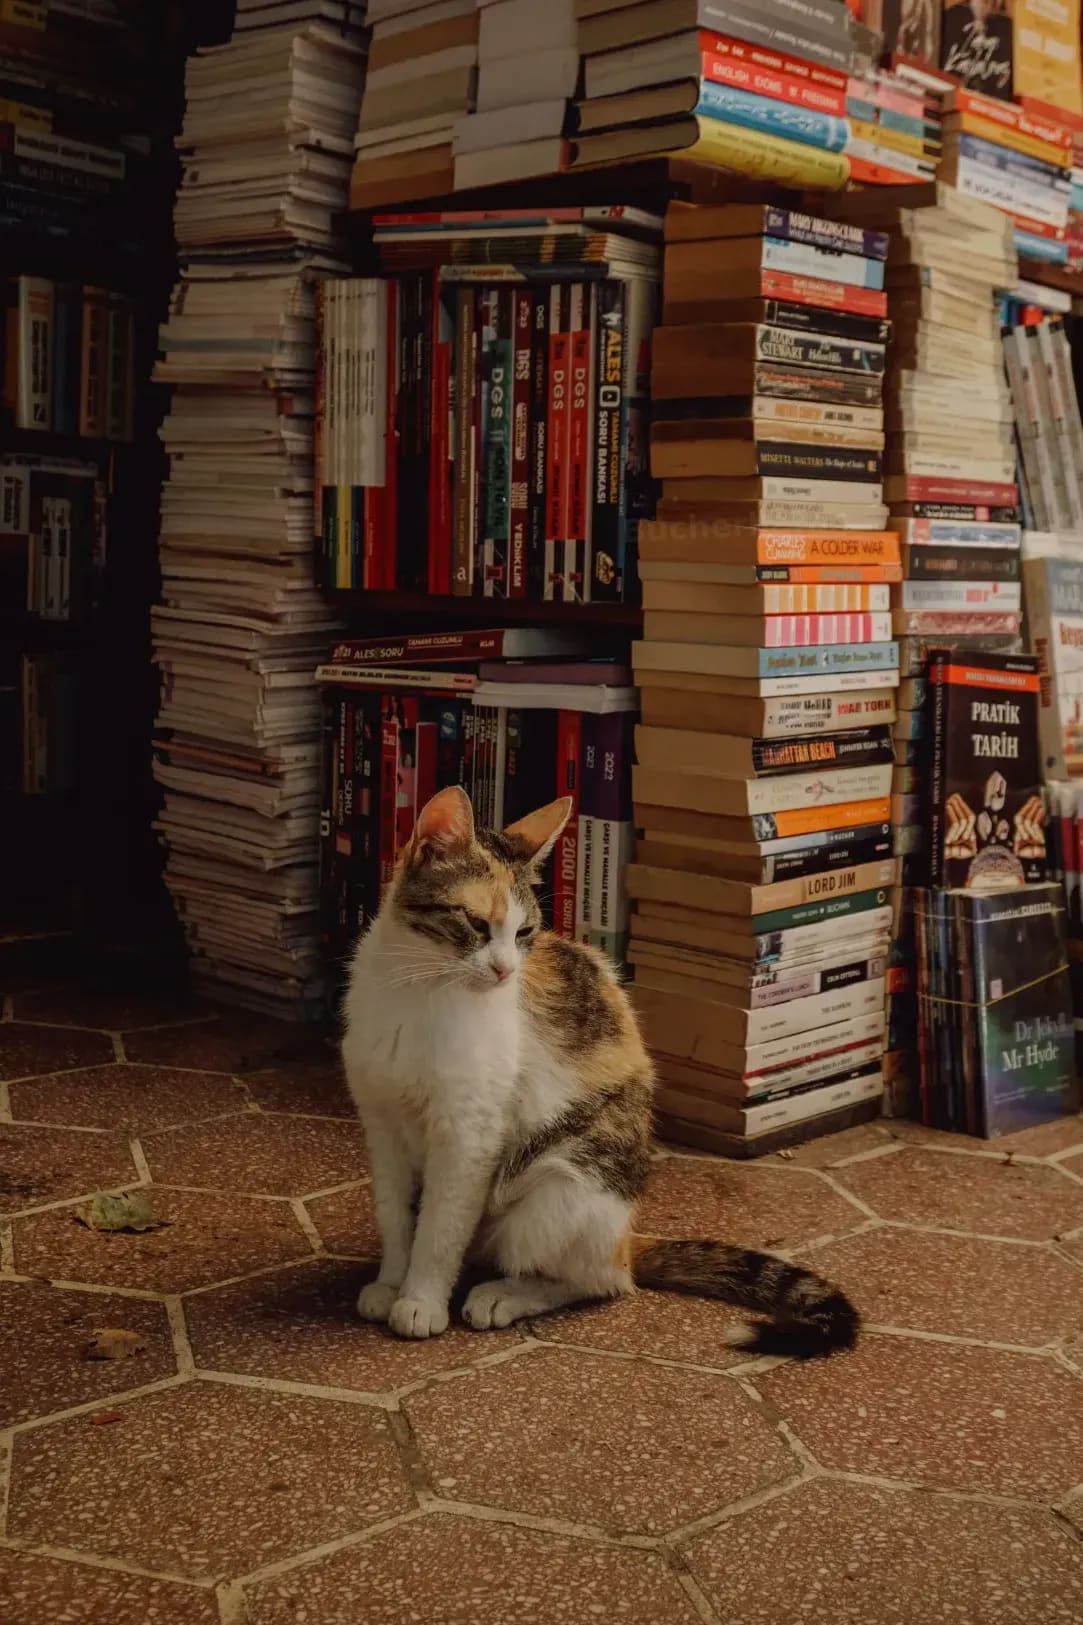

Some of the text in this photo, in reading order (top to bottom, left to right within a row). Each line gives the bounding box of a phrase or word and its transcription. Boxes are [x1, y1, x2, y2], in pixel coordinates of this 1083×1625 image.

[713, 62, 749, 82] ENGLISH
[607, 329, 622, 383] ALES
[763, 341, 804, 359] STEWART
[516, 349, 531, 381] DGS
[490, 367, 504, 420] DGS
[552, 370, 565, 411] DGS
[573, 367, 586, 409] DGS
[535, 421, 545, 495] SORU BANKASI
[596, 410, 609, 504] SORU BANKASI
[811, 540, 885, 555] A COLDER WAR
[353, 649, 375, 659] ALES
[380, 647, 404, 658] SORU
[838, 699, 891, 716] WAR TORN
[971, 700, 1021, 725] PRATİK
[810, 740, 837, 761] BEACH
[971, 730, 1020, 759] TARİH
[604, 752, 614, 780] 2022
[584, 820, 594, 840] ÇARŞI
[601, 822, 611, 844] ÇARŞI
[562, 836, 576, 880] 2000
[584, 841, 593, 851] VE
[601, 845, 610, 855] VE
[583, 852, 593, 885] MAHALLE
[600, 856, 610, 890] MAHALLE
[808, 872, 856, 895] LORD JIM
[563, 898, 573, 928] SORU
[758, 993, 767, 1001] THE
[1015, 1020, 1032, 1043] Dr
[1002, 1041, 1060, 1072] Mr Hyde
